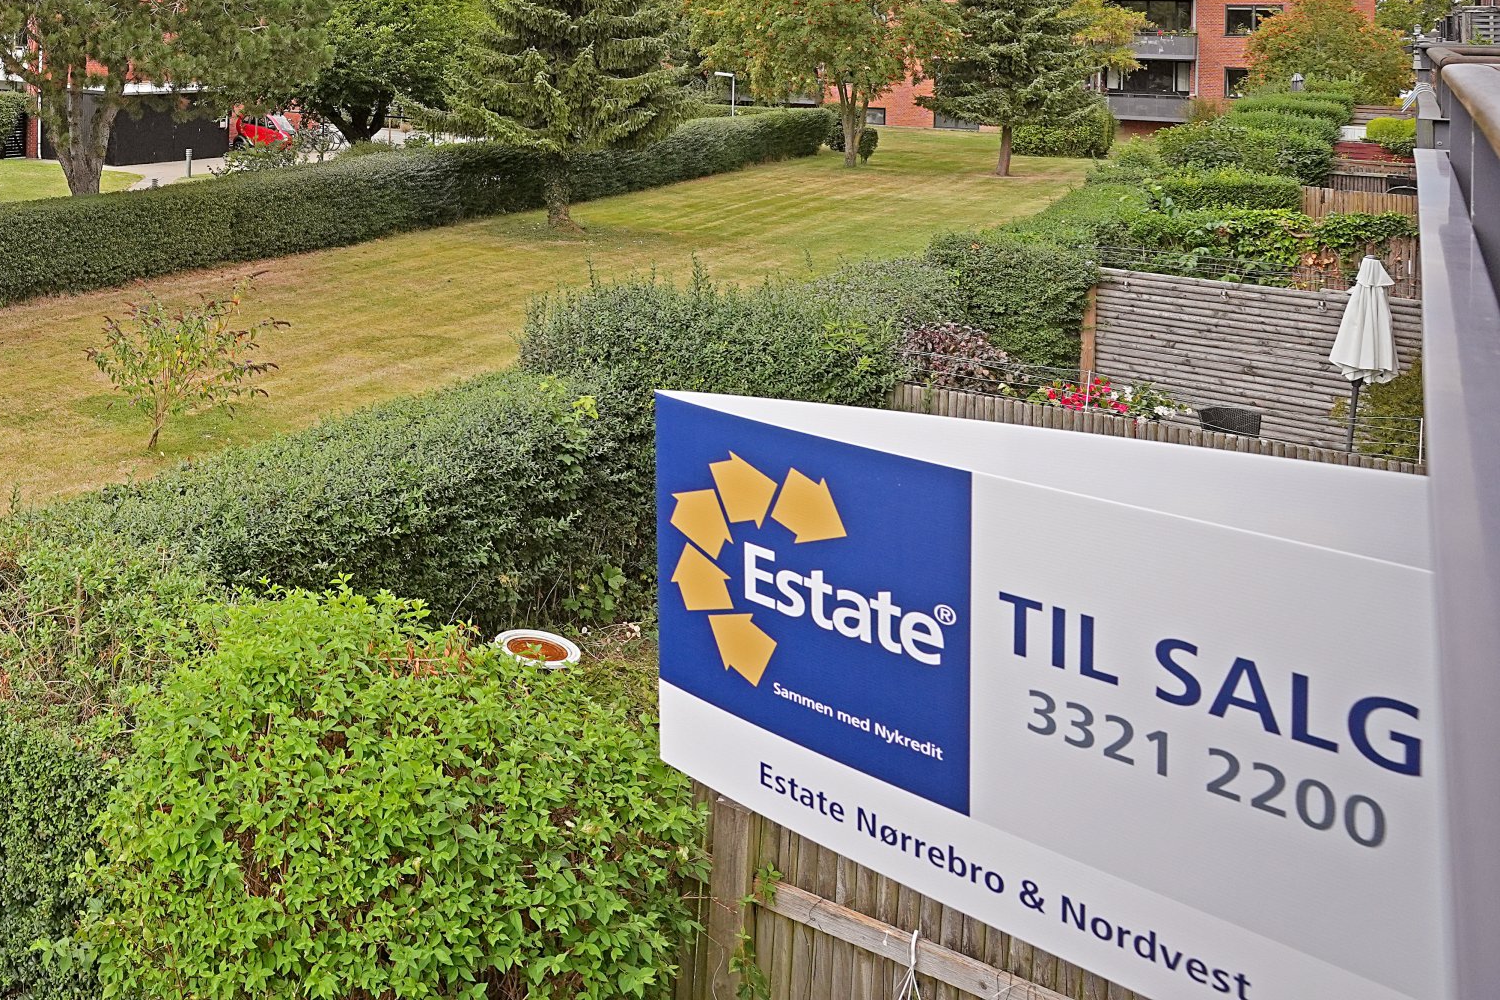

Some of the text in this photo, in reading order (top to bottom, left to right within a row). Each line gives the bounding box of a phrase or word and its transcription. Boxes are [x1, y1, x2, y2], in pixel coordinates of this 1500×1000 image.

[772, 681, 944, 761] Sammen med Nykredit
[999, 591, 1422, 776] TIL SALG
[1027, 690, 1386, 848] 3321 2200
[759, 761, 1252, 1000] Estate Nørrebro & Nordvest
